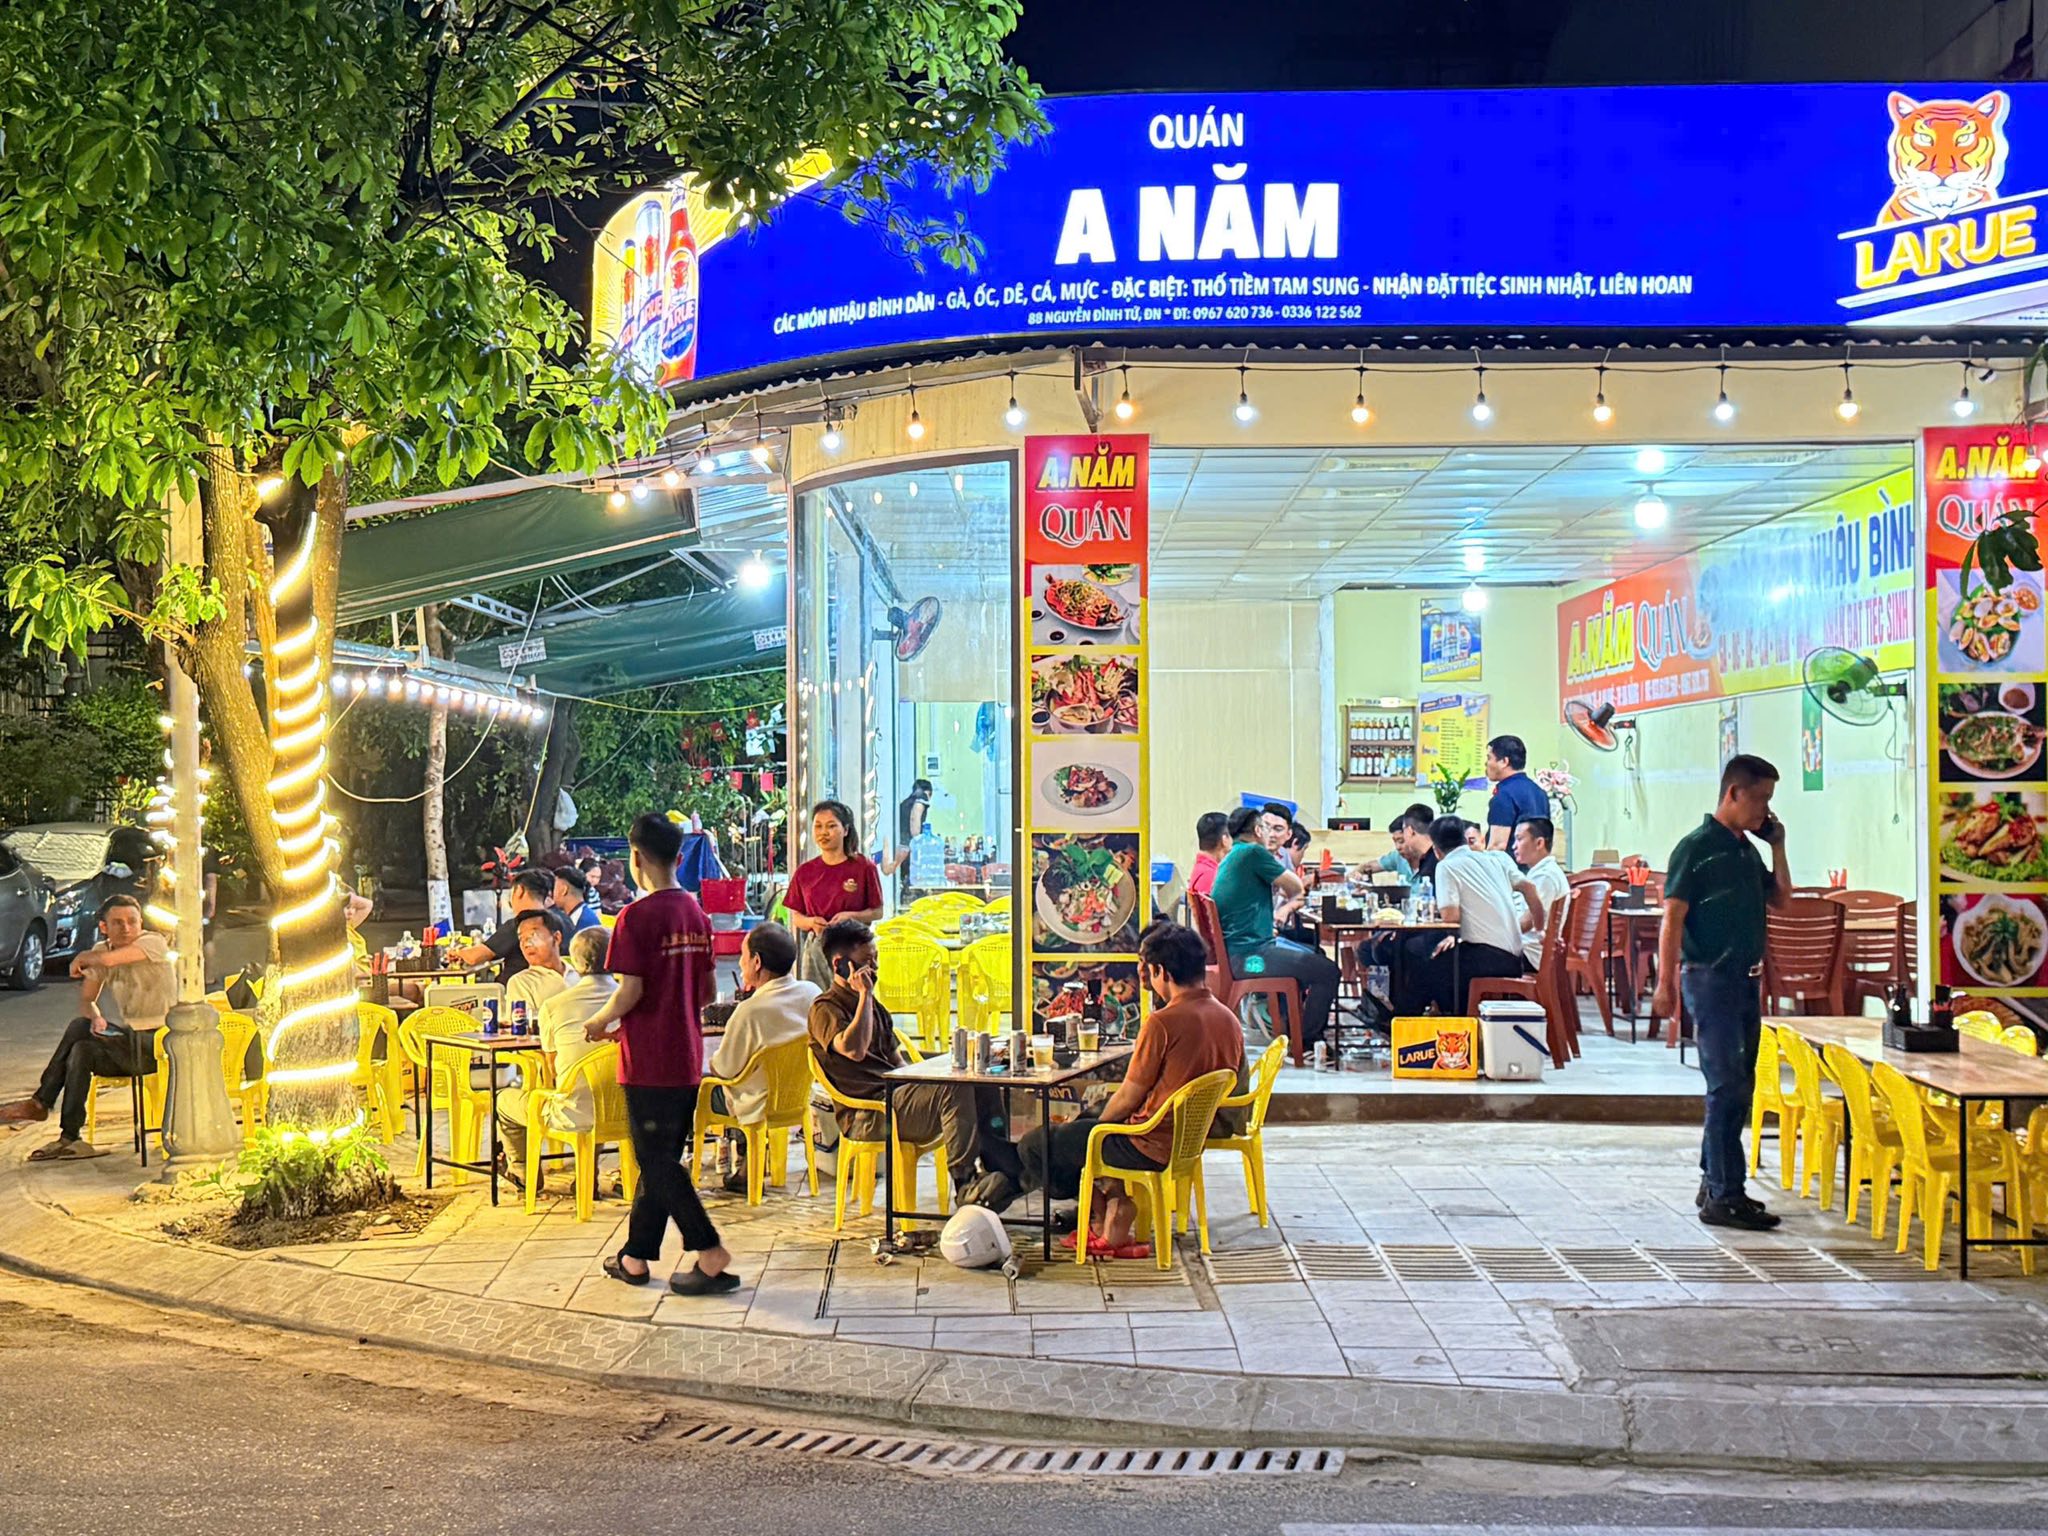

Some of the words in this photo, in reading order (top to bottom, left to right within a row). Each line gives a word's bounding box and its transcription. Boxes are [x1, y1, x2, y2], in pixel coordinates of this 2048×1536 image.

[1148, 104, 1244, 150] QUÁN
[1054, 188, 1117, 265] A
[1138, 162, 1340, 262] NĂM
[1856, 205, 2037, 289] LARUE
[773, 312, 797, 335] CÁC
[796, 306, 828, 331] MÓN
[828, 300, 867, 325] NHẬU
[867, 296, 904, 319] BÌNH
[904, 290, 936, 314] DÂN
[945, 286, 971, 310] GÀ,
[973, 282, 1000, 308] ỐC,
[1003, 281, 1029, 306] DÊ,
[1031, 279, 1057, 304] CÁ,
[1060, 278, 1100, 305] MỰC
[1111, 276, 1146, 303] ĐẶC
[1148, 274, 1189, 302] BIỆT:
[1191, 271, 1227, 297] THỐ
[1271, 276, 1309, 295] TAM
[1312, 276, 1360, 296] SUNG
[1372, 272, 1423, 300] NHẬN
[1425, 272, 1462, 299] ĐẶT
[1460, 272, 1497, 299] TIỆC
[1499, 275, 1543, 295] SINH
[1545, 271, 1597, 299] NHẬT,
[1599, 271, 1636, 295] LIÊN
[1641, 275, 1693, 295] HOAN
[1027, 311, 1044, 325] 88
[1092, 306, 1123, 322] ĐÌNH
[1192, 306, 1224, 320] 0967
[1225, 306, 1249, 320] 620
[1250, 305, 1274, 319] 736
[1281, 305, 1313, 319] 0336
[1314, 305, 1337, 319] 122
[1339, 305, 1362, 319] 562
[1038, 442, 1136, 488] A.NĂM
[1040, 501, 1132, 548] QUÁN
[1399, 1048, 1436, 1065] LARUE
